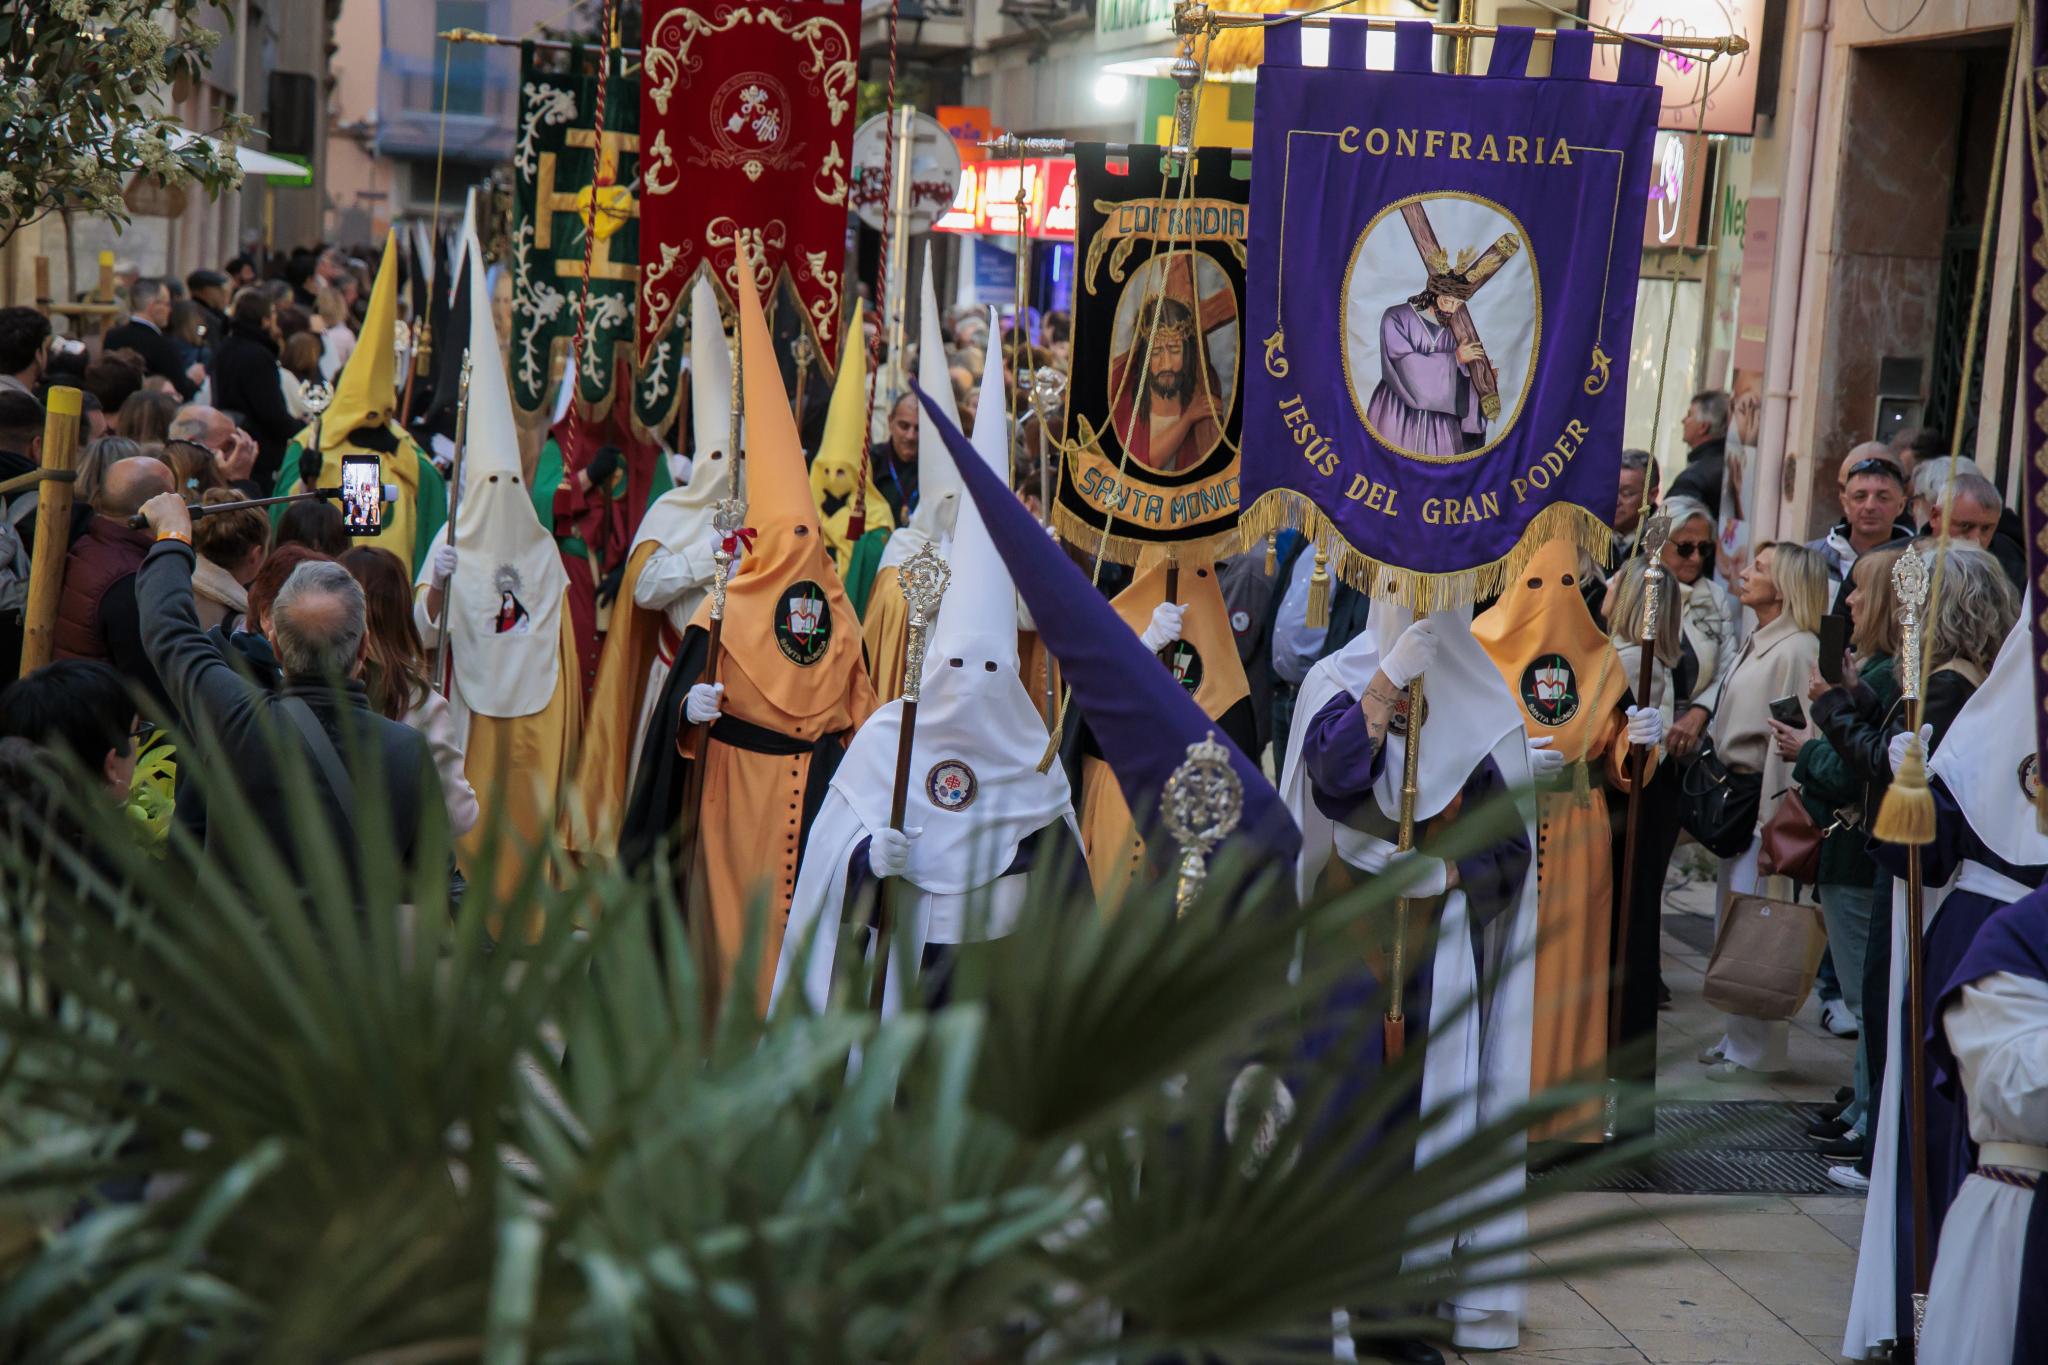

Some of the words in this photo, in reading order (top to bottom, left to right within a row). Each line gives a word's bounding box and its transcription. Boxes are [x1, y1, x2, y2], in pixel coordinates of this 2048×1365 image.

[1338, 125, 1574, 166] CONFRARIA
[1118, 205, 1245, 237] COFRADIA
[1278, 393, 1341, 478] JESÚS
[1344, 473, 1399, 517] DEL
[1421, 491, 1501, 526] GRAN
[1510, 417, 1590, 504] PODER
[1078, 467, 1165, 524] SANTA
[1170, 473, 1241, 524] MONIC
[779, 637, 802, 662] SANTA
[1527, 703, 1550, 724] SANTA
